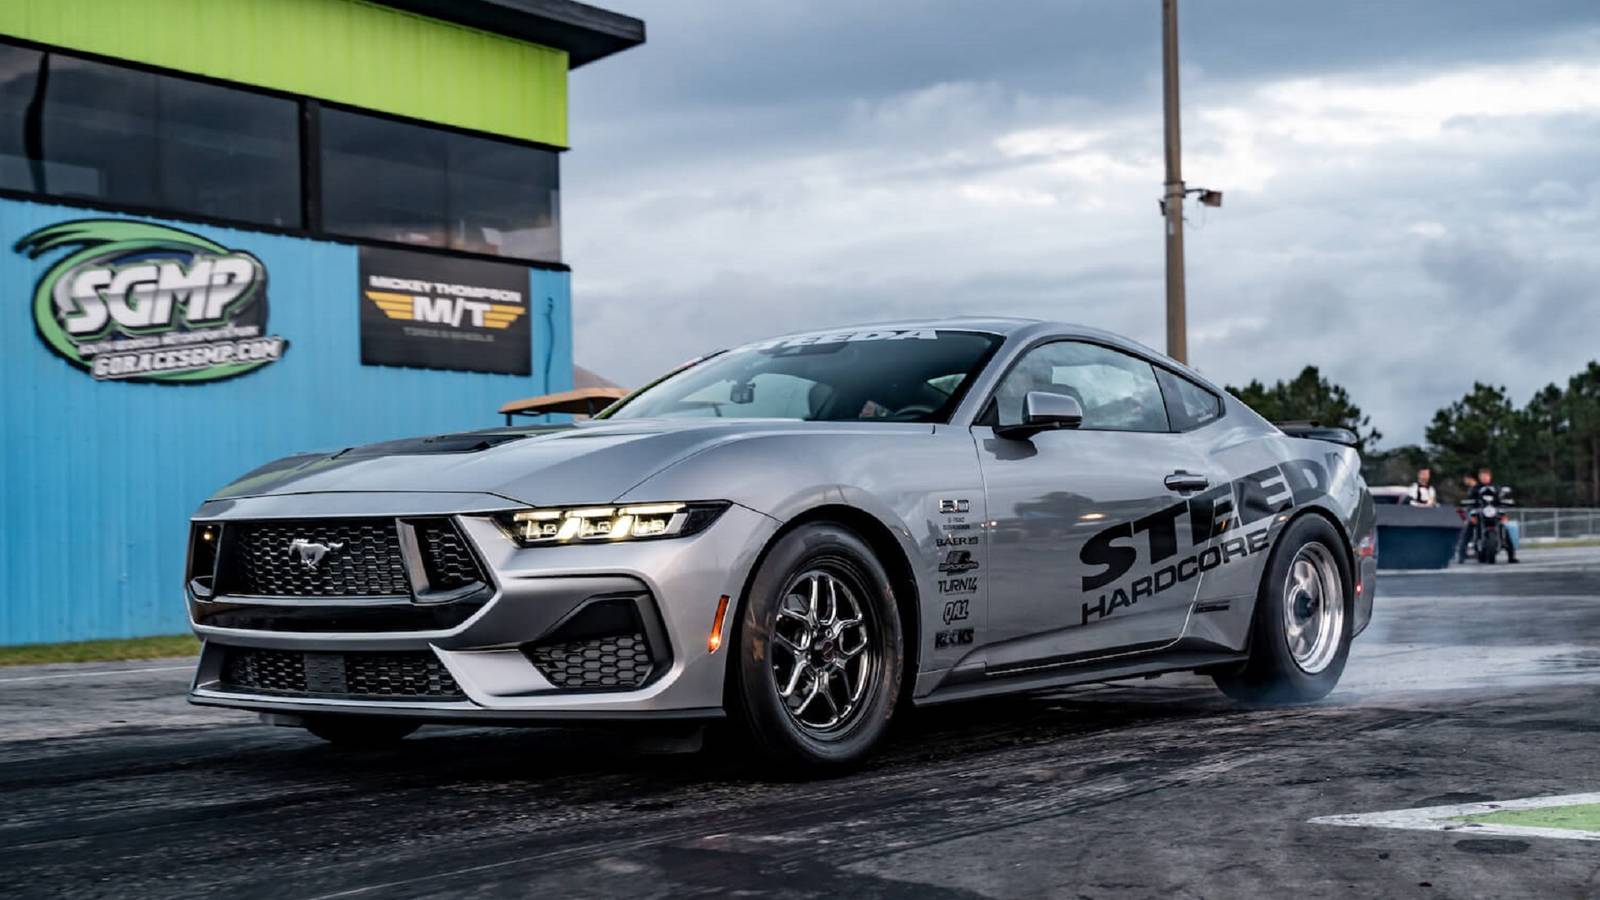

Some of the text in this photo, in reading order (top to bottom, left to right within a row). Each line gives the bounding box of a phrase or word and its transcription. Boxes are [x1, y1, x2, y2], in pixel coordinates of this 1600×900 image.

[65, 257, 254, 334] SGMP
[369, 275, 434, 294] MICKEY
[413, 296, 491, 328] M/T
[936, 537, 967, 547] BAER
[1082, 529, 1269, 625] HARDCORE
